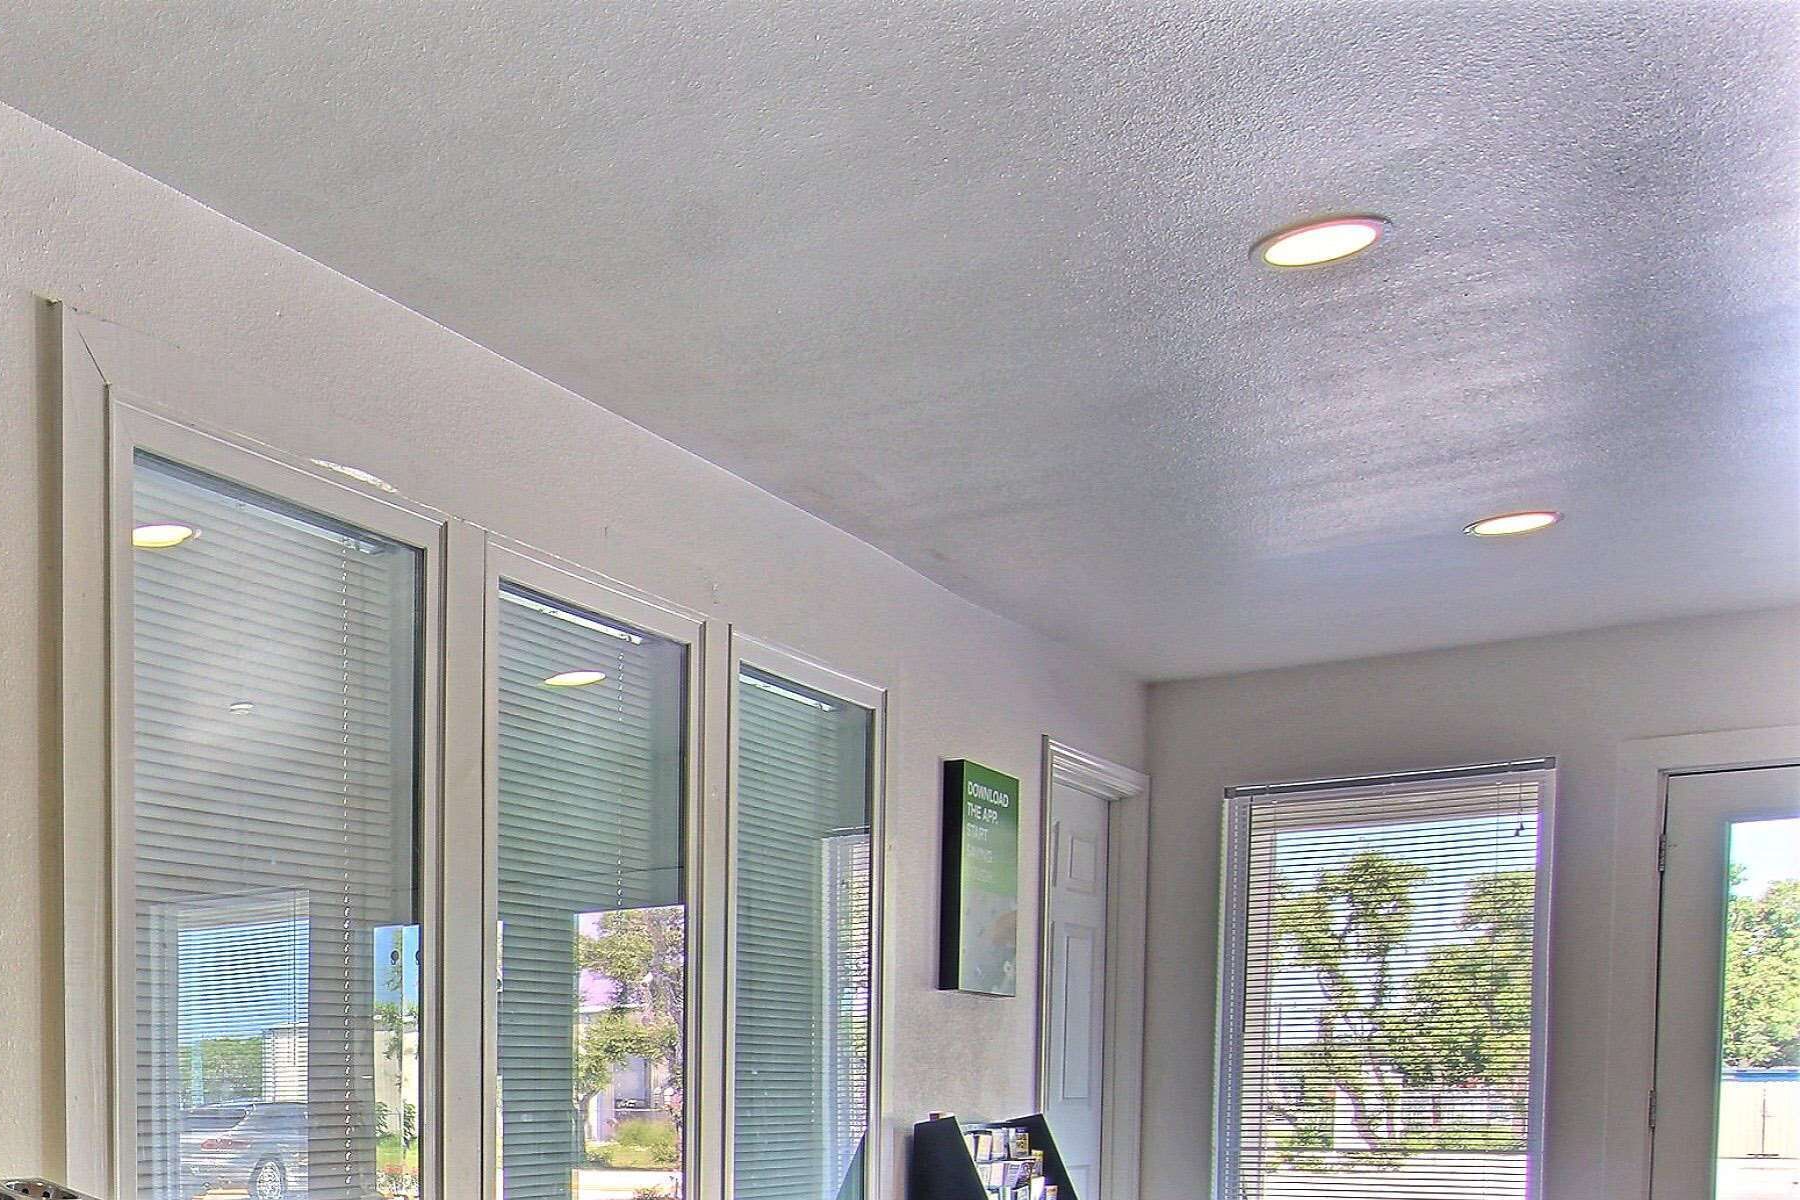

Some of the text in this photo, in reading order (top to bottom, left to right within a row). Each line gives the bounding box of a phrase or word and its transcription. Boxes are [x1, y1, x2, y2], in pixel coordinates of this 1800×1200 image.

[966, 780, 1009, 808] DOWNLOAD
[966, 801, 999, 825] THE APP.
